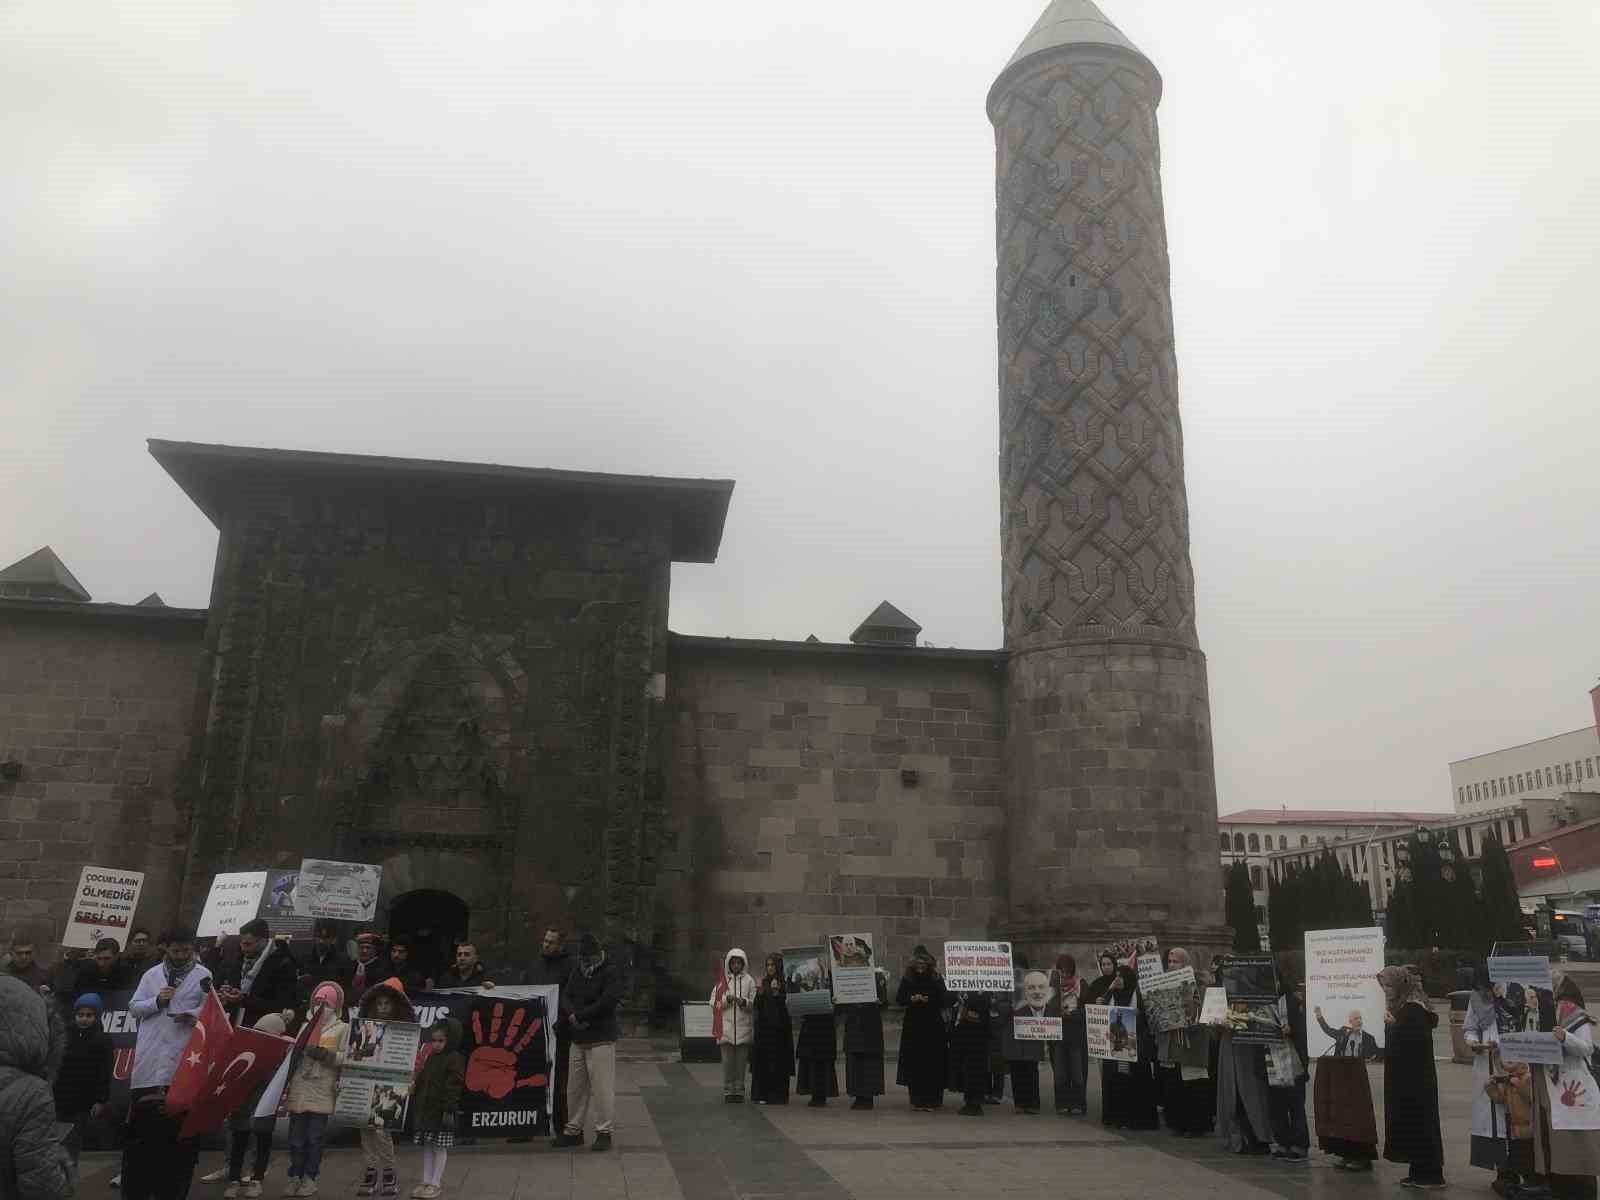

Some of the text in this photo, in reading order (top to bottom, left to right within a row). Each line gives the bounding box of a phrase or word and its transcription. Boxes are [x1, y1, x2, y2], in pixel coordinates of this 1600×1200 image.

[86, 873, 139, 887] ÇOCUKLARIN
[82, 885, 136, 902] ÖLMEDİĞİ
[949, 978, 1012, 990] İSTEMİYORUZ
[472, 1109, 538, 1128] ERZURUM
